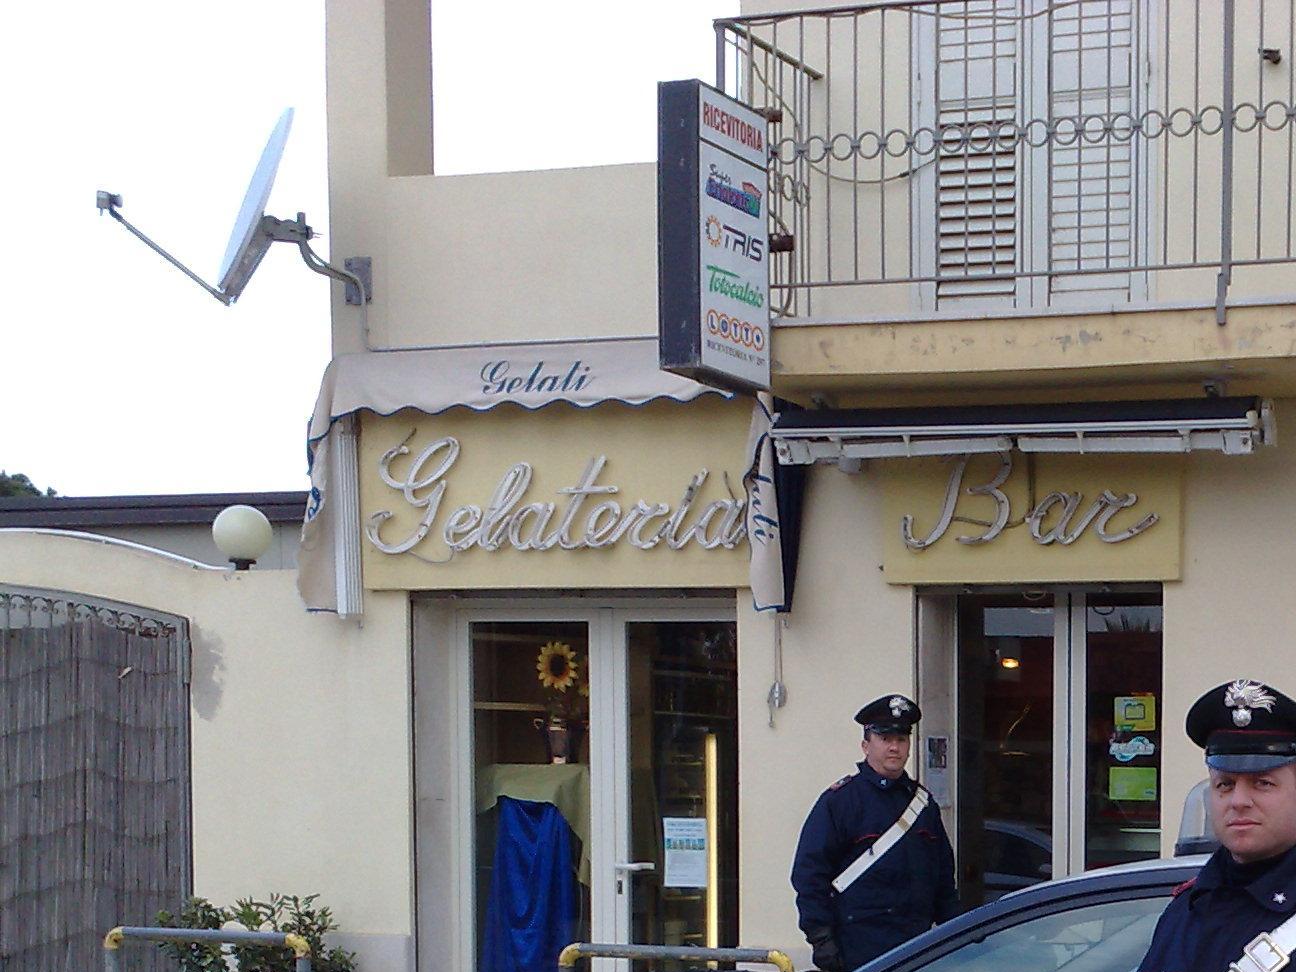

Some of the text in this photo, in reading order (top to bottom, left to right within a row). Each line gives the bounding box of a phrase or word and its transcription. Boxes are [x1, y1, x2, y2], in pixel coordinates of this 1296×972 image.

[707, 310, 764, 350] LOTTO
[366, 436, 748, 555] Gelateria
[903, 450, 1160, 551] Bar
